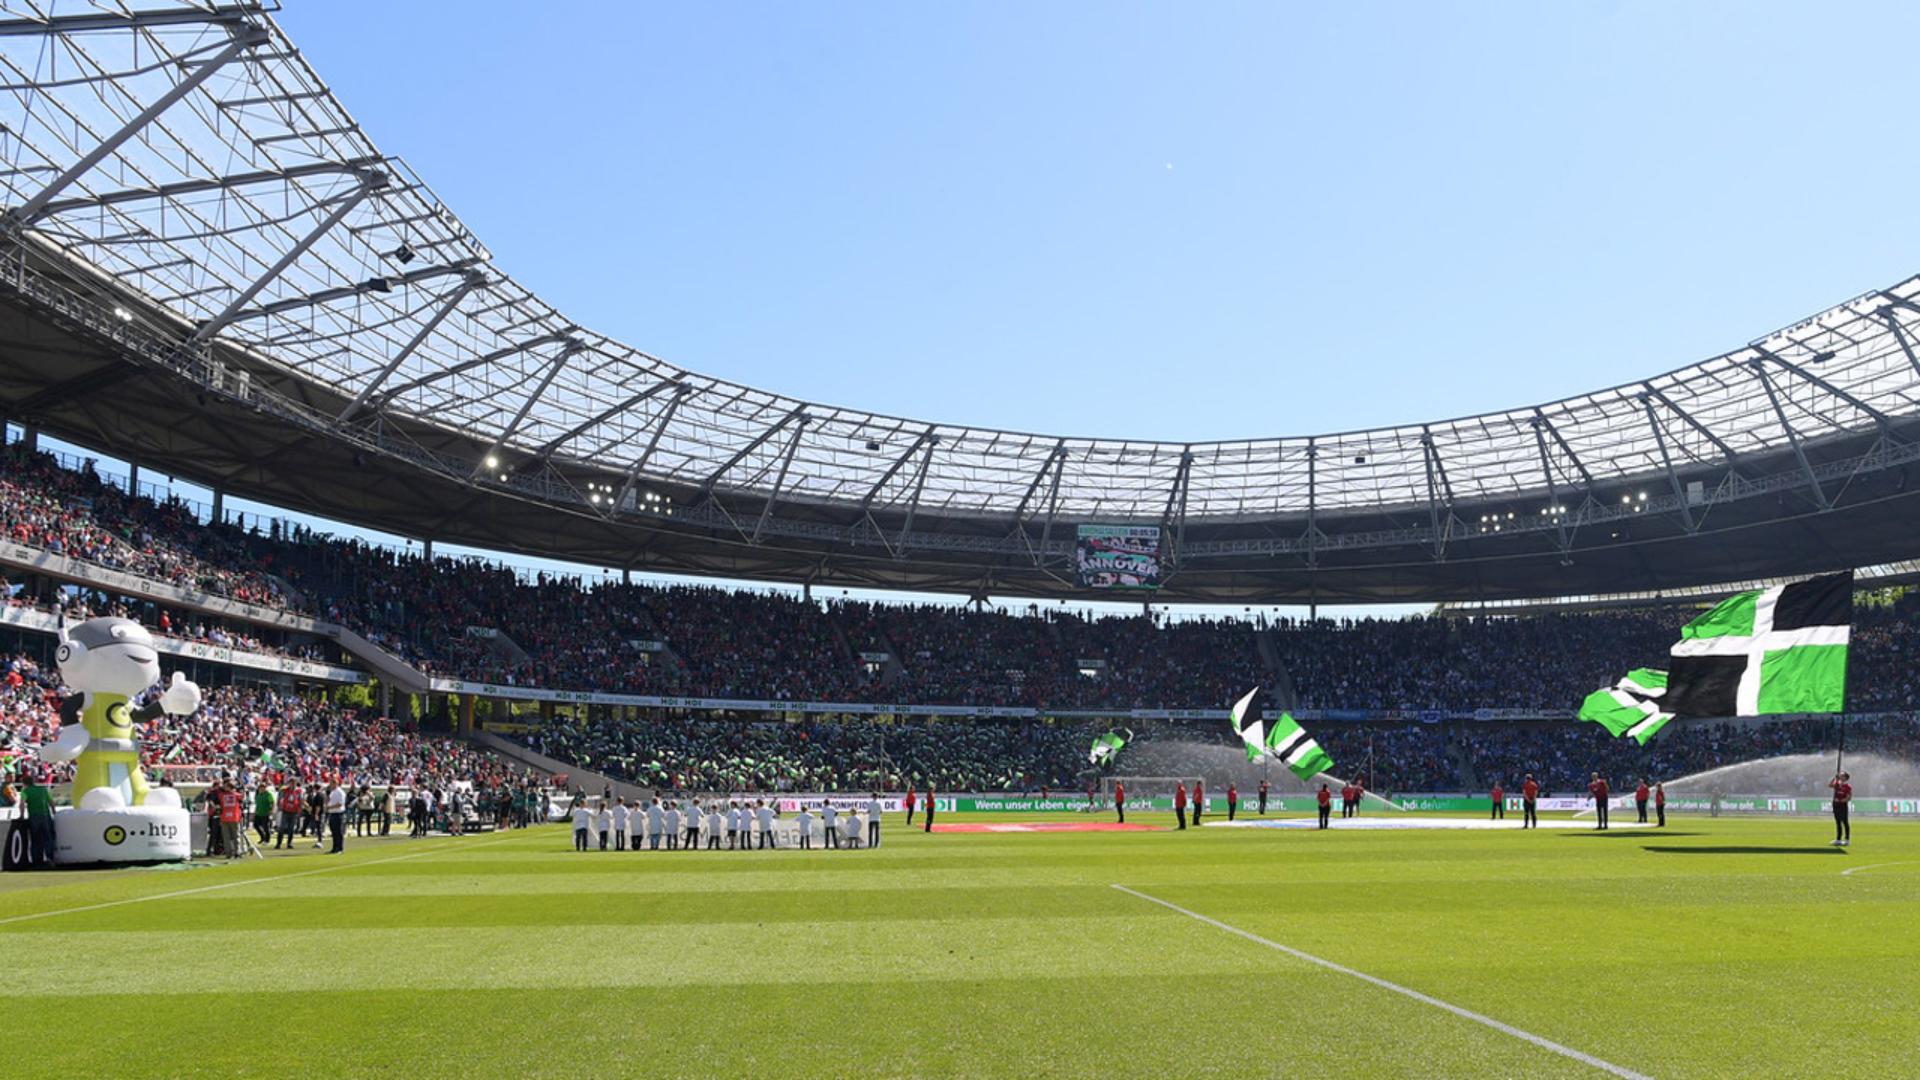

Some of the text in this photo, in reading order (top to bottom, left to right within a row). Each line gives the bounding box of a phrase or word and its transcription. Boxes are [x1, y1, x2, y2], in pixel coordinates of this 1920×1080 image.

[975, 800, 1003, 810] Wenn
[1005, 801, 1032, 810] unser
[1035, 800, 1064, 810] Leben
[1891, 800, 1917, 813] HDI
[148, 822, 178, 839] htp
